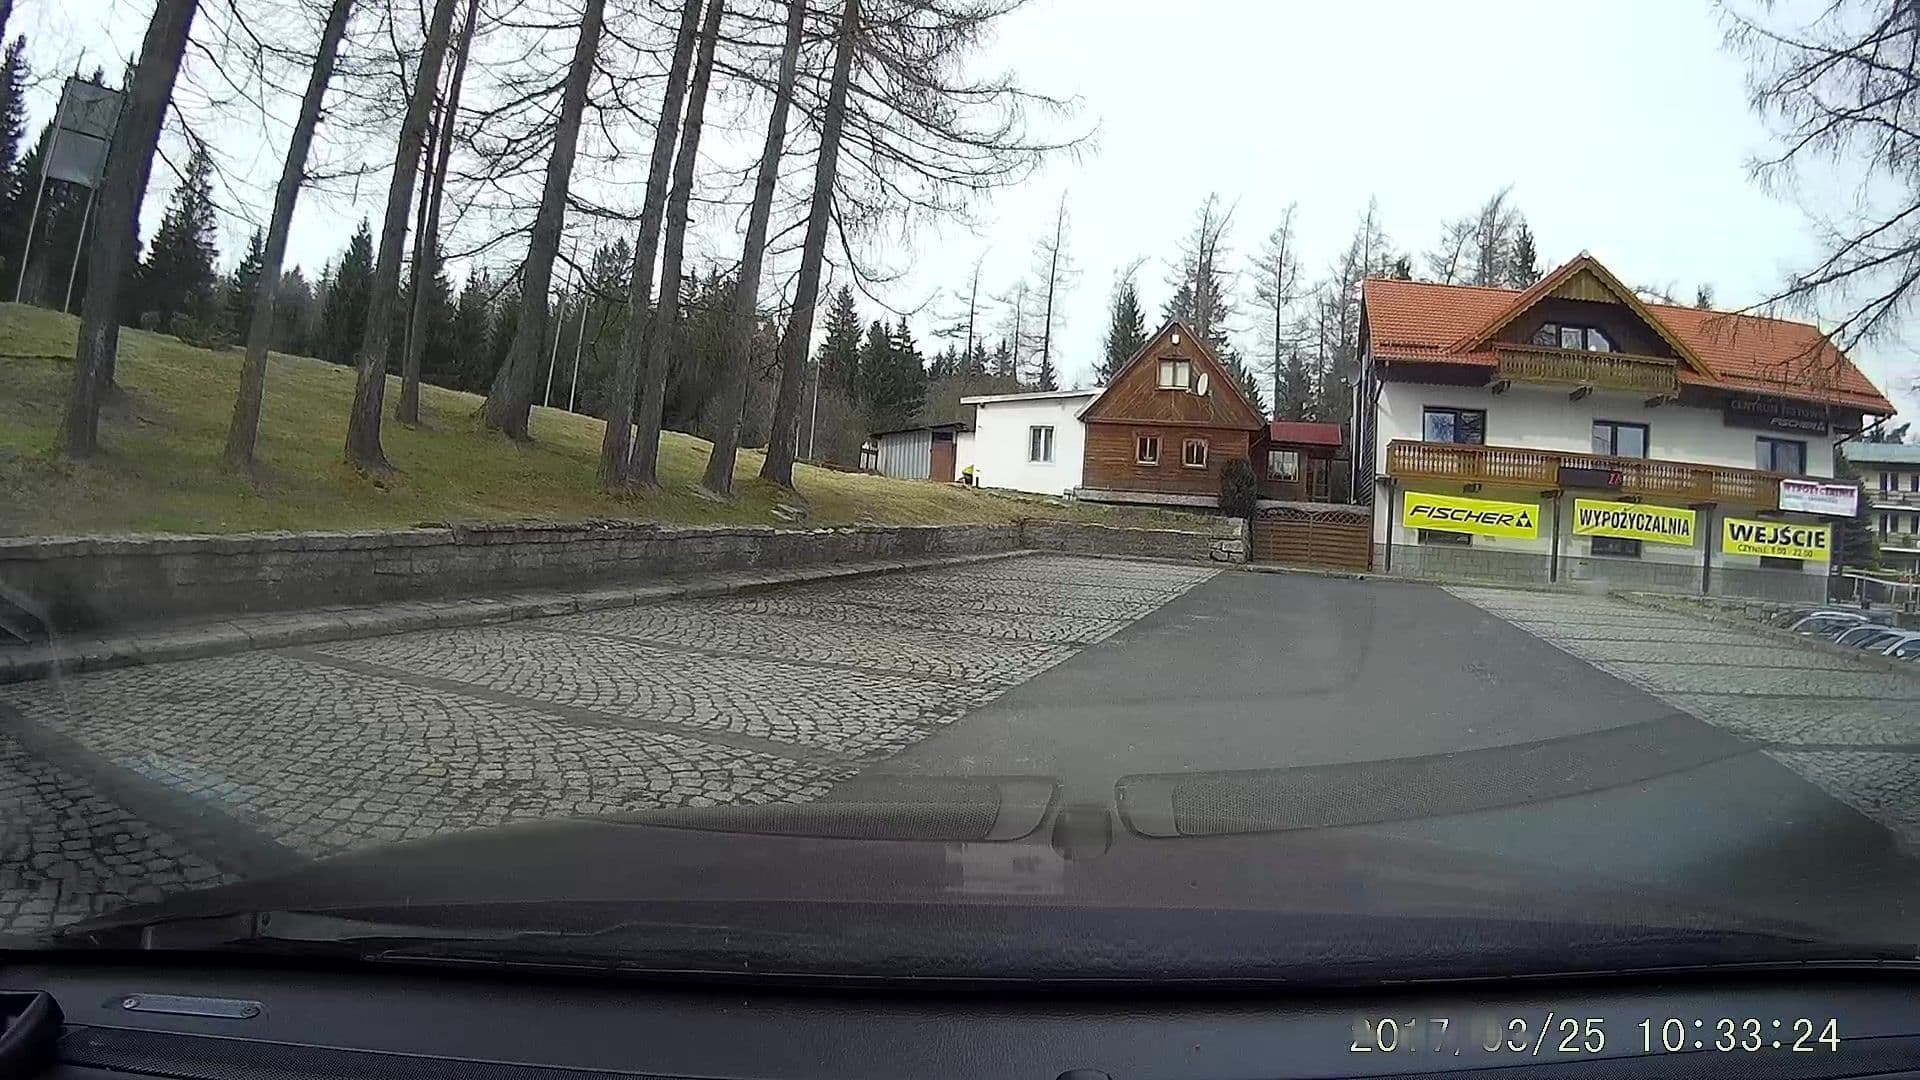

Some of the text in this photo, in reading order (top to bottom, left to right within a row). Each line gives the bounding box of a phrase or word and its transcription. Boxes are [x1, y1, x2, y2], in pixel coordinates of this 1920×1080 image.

[1409, 505, 1514, 526] FISCHER
[1579, 507, 1690, 537] WYPOŻYCZALNIA
[1729, 523, 1825, 548] WEJŚCIE
